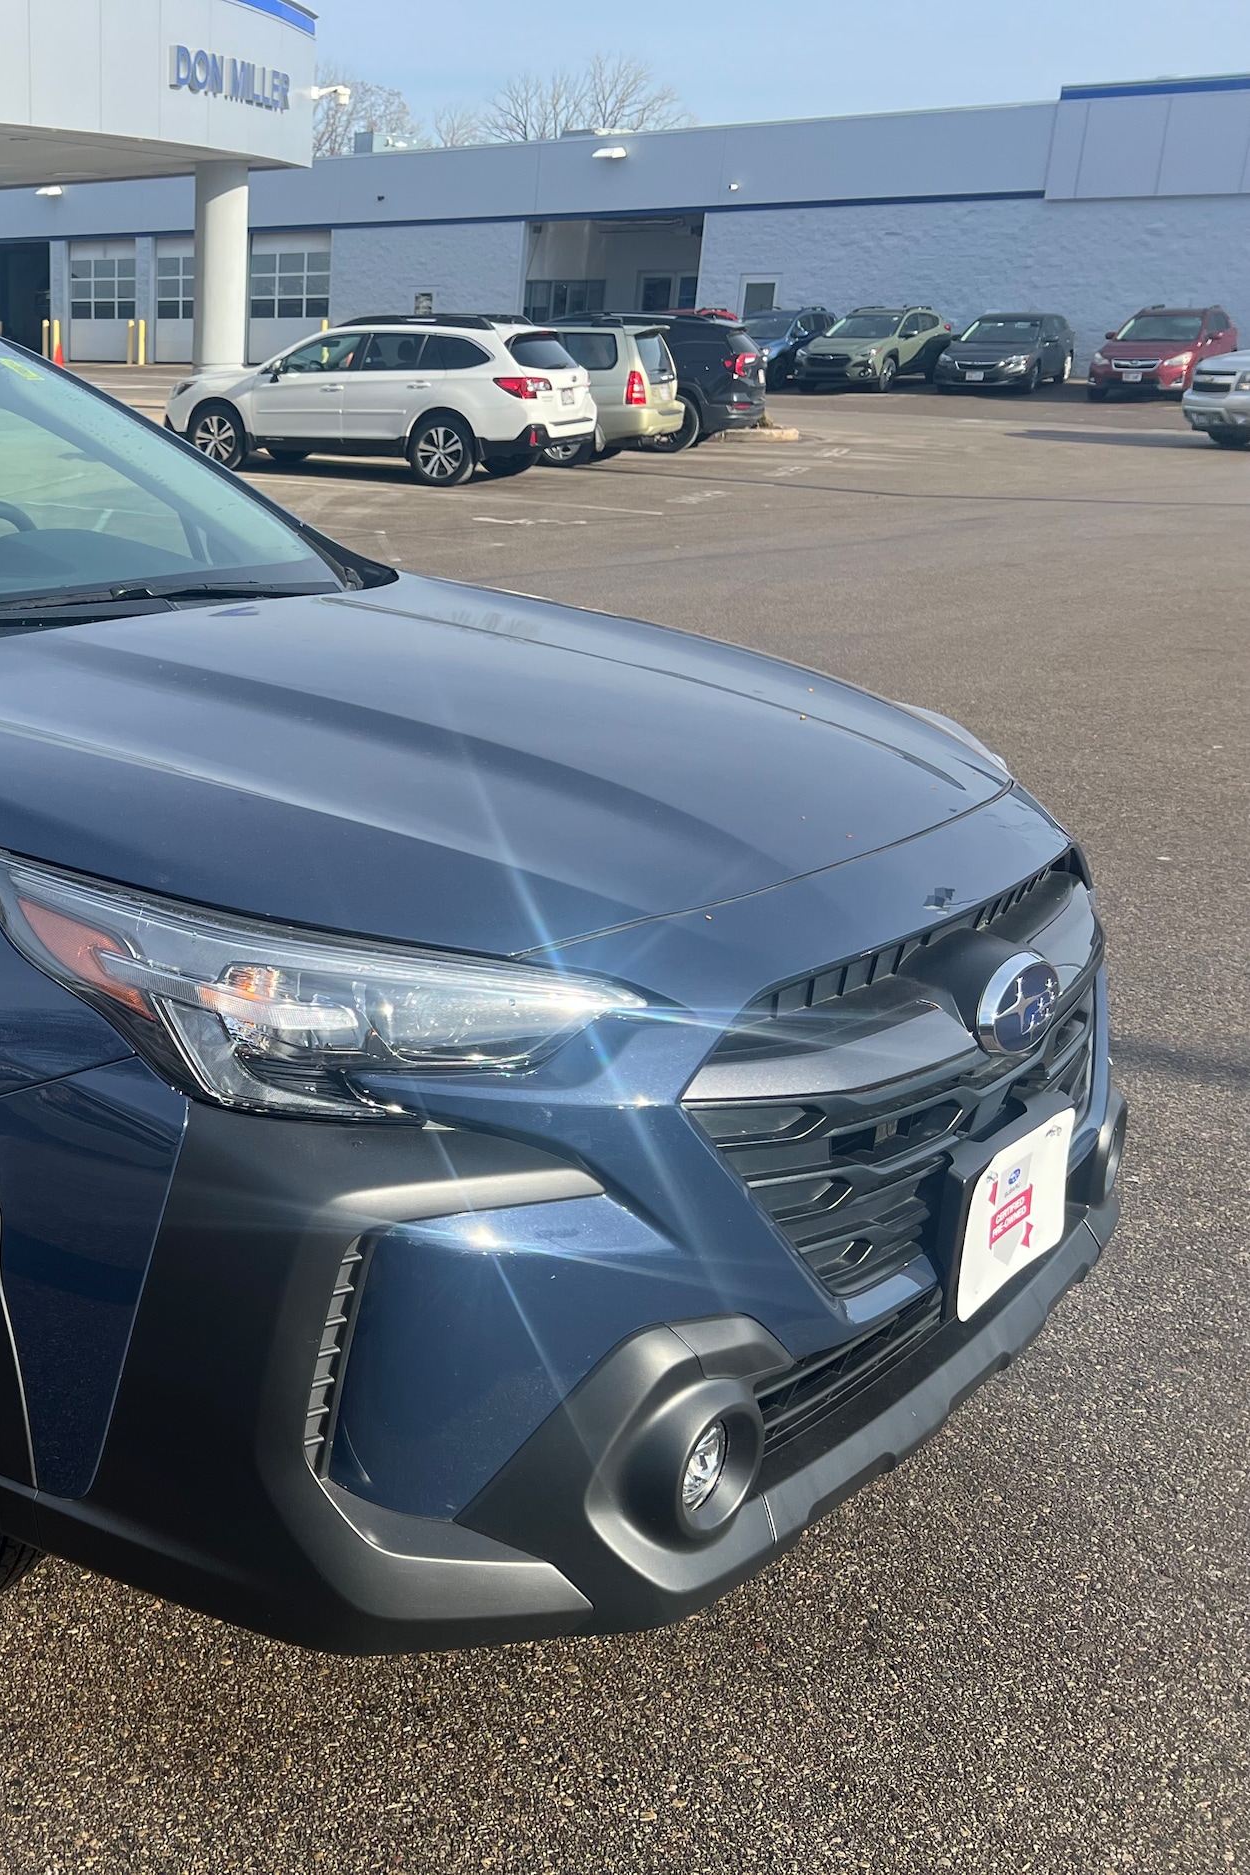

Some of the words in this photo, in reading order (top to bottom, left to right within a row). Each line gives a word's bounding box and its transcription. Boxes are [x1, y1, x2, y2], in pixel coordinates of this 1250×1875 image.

[169, 44, 224, 96] DON
[225, 57, 290, 113] MILLER
[991, 1204, 1027, 1240] PRE-OWNED
[995, 1195, 1025, 1226] CERTIFIED
